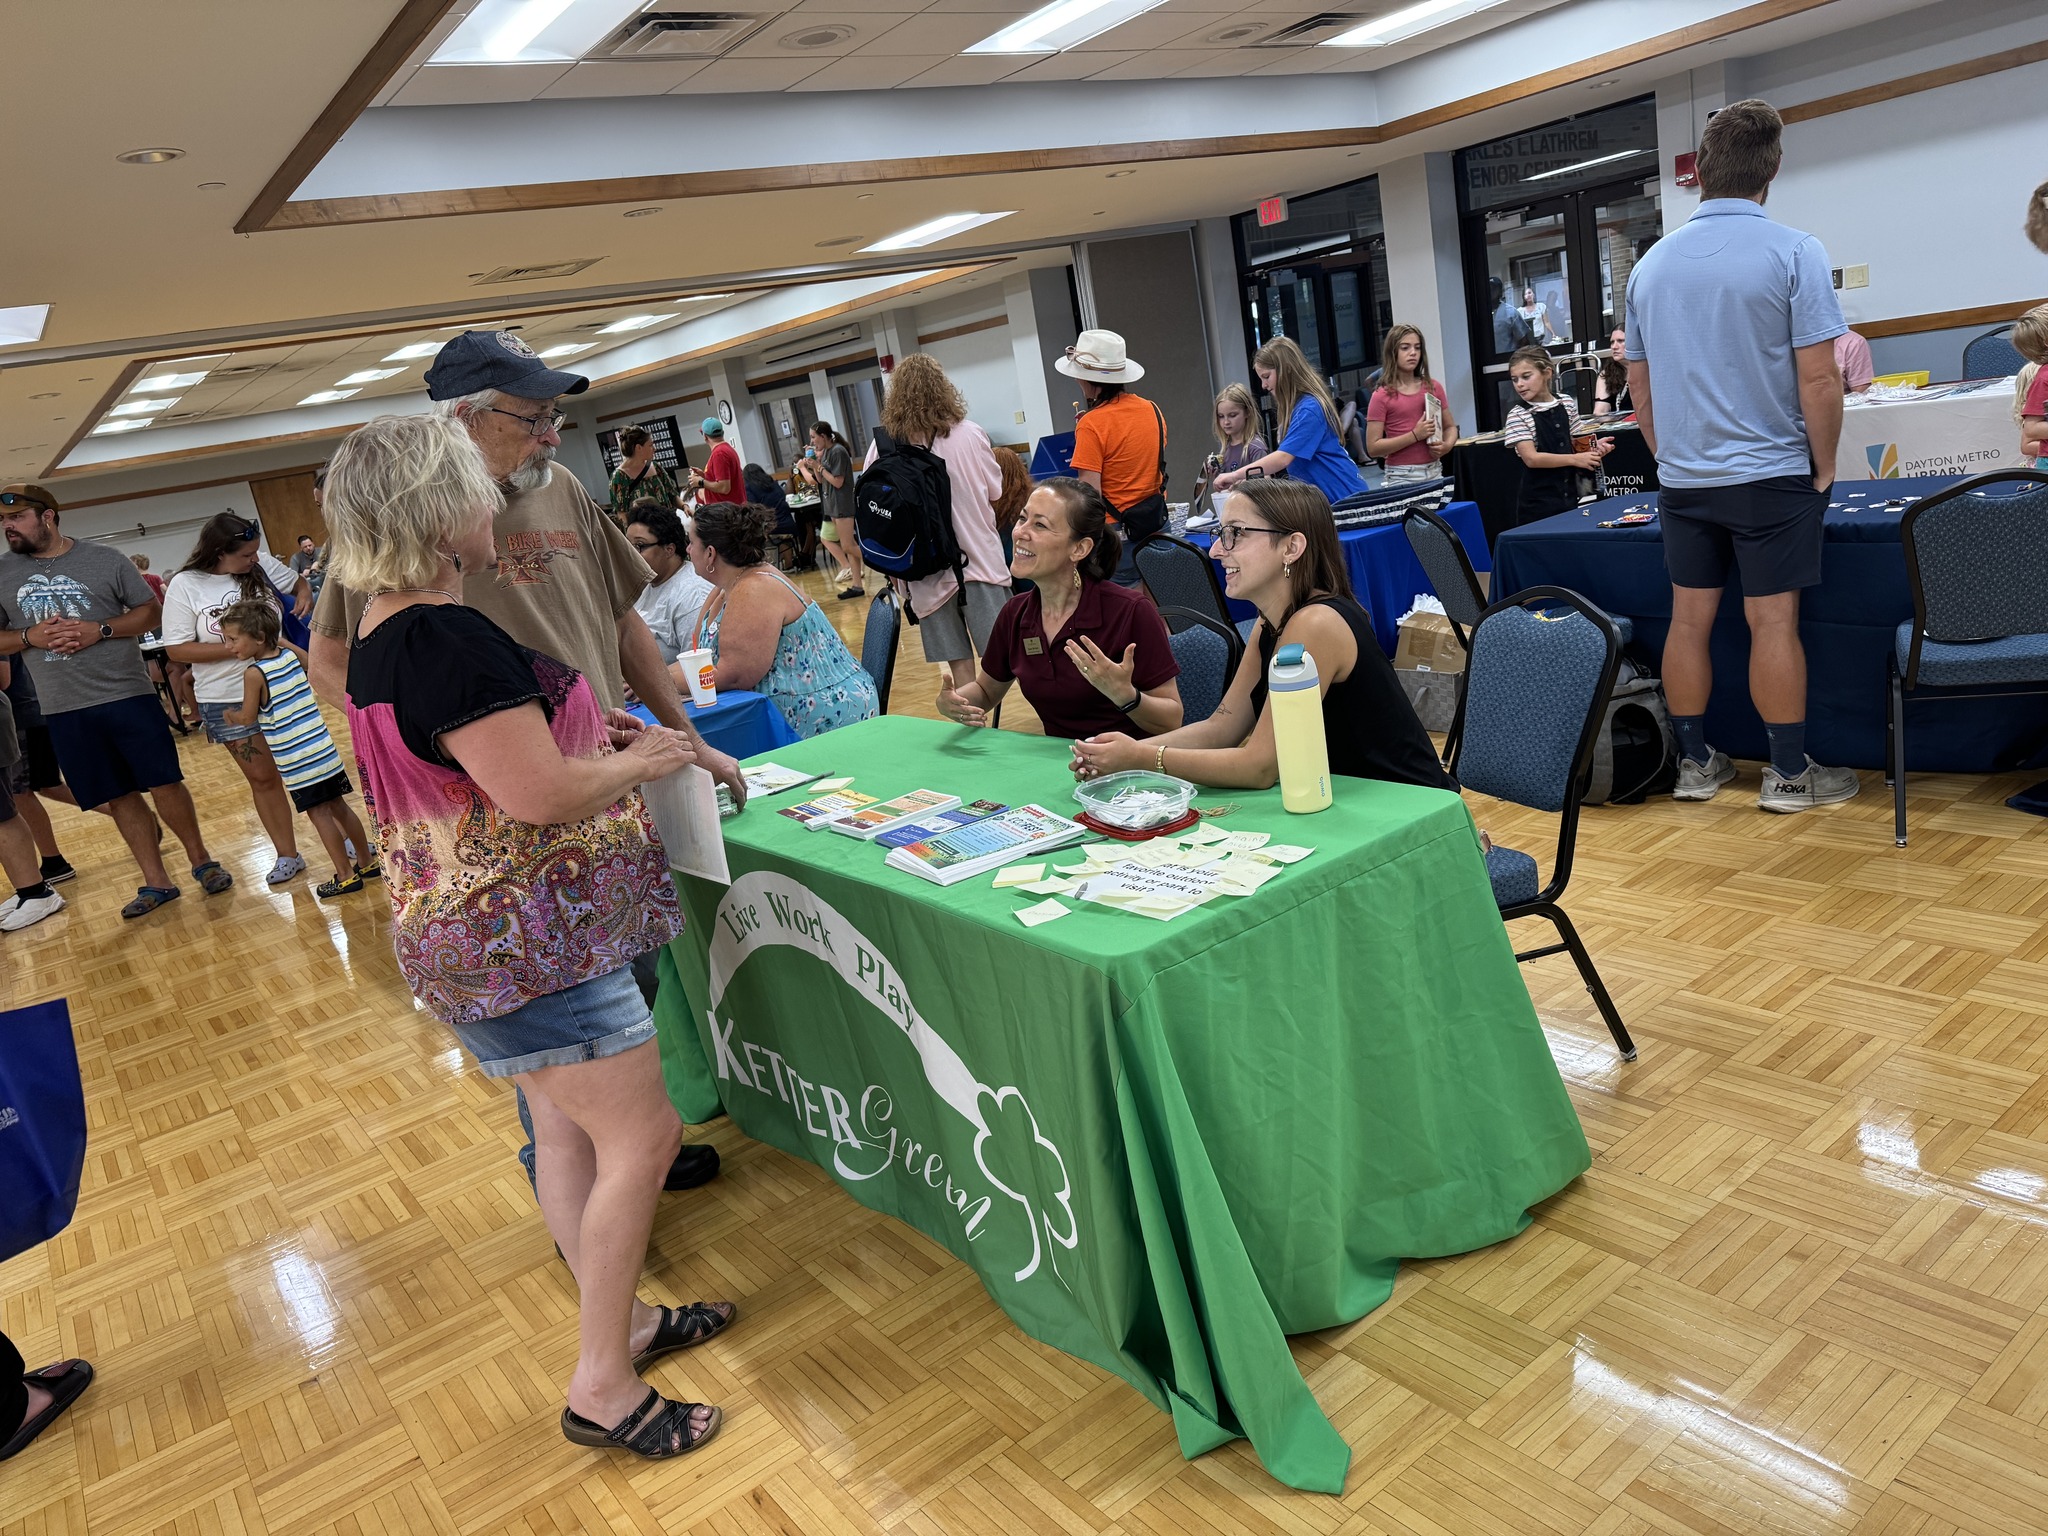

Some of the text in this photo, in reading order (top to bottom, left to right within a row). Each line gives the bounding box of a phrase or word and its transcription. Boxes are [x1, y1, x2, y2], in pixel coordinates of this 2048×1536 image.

[1531, 130, 1598, 154] LATHREM
[1469, 163, 1519, 189] ENIOR
[1260, 198, 1282, 225] EXIT
[1905, 449, 2001, 471] DAYTON METRO
[1603, 475, 1644, 485] DAYTON
[505, 532, 543, 553] BIKE
[545, 530, 580, 550] WEEK
[699, 677, 715, 687] KIN
[1774, 782, 1807, 794] HOKA
[1122, 863, 1165, 876] favorite
[1187, 868, 1219, 878] your
[1103, 870, 1144, 881] activity
[1157, 882, 1188, 891] park
[1187, 887, 1202, 896] to
[1121, 882, 1154, 892] visit?
[719, 891, 914, 1032] Live Work Play
